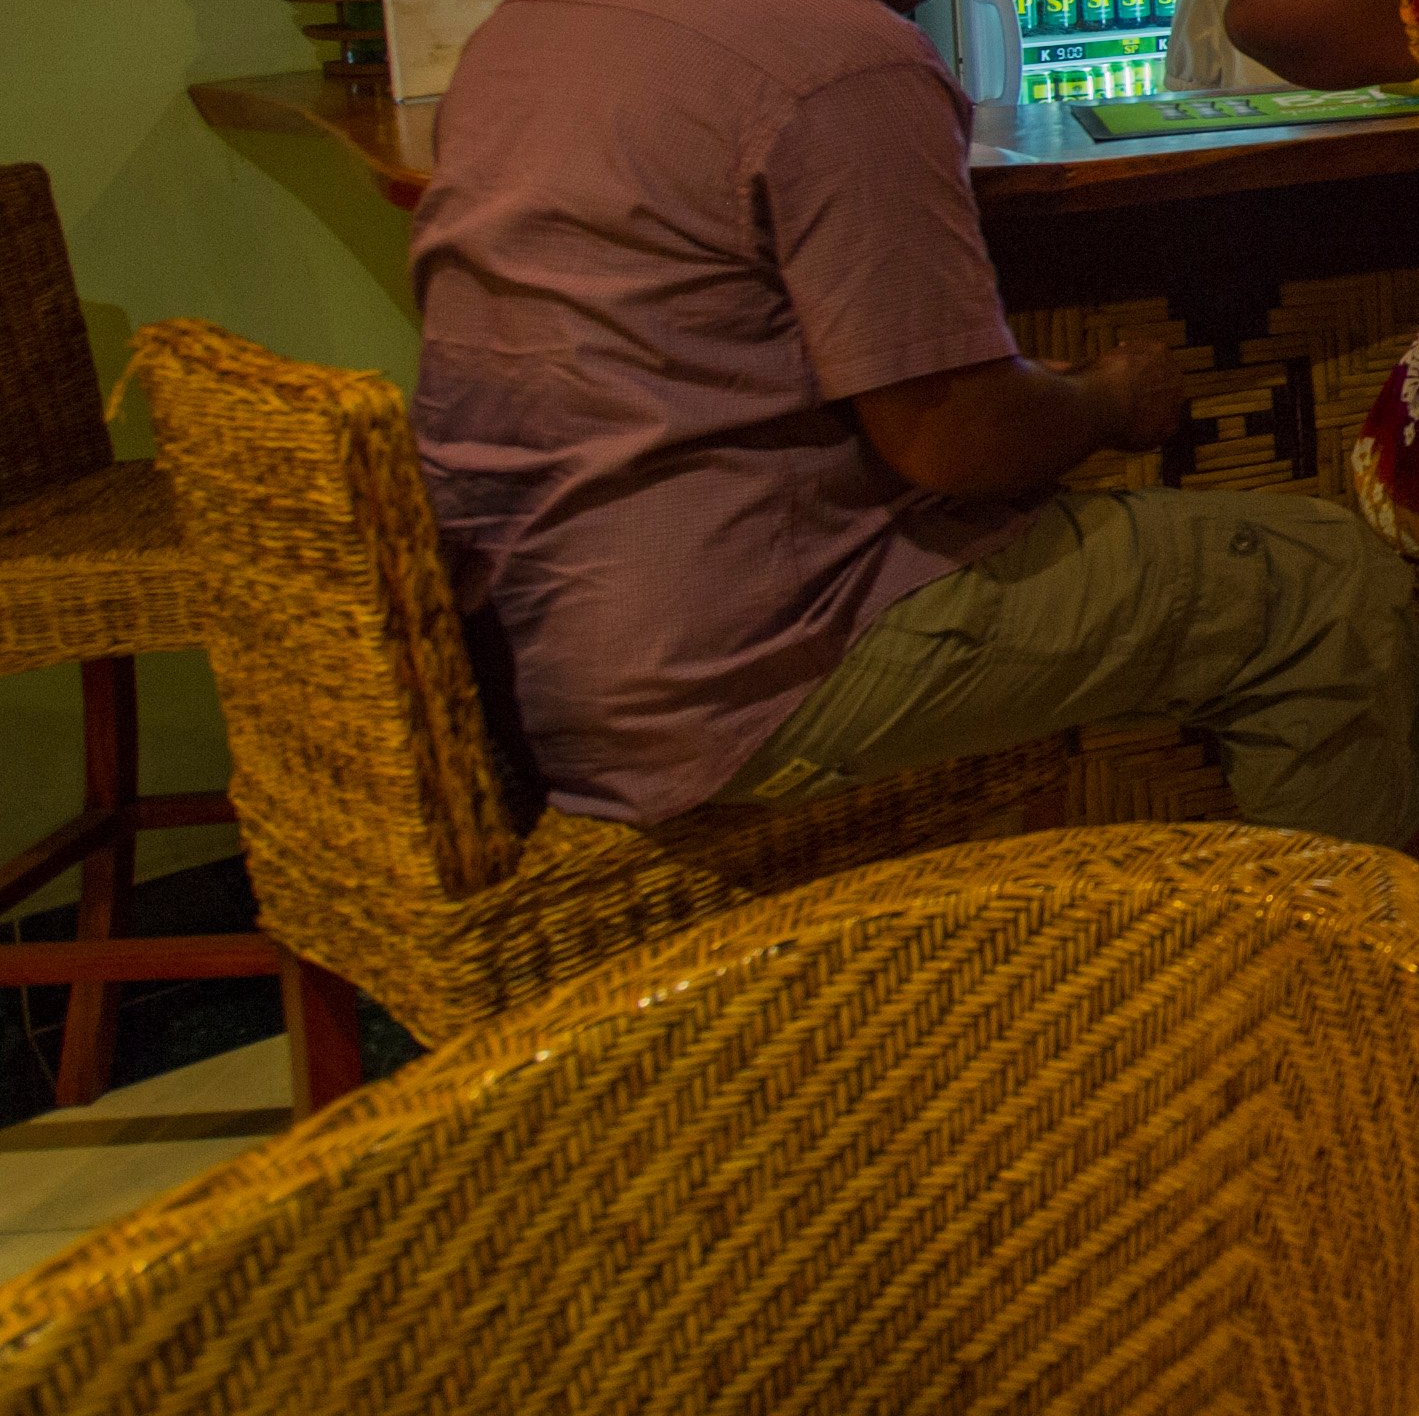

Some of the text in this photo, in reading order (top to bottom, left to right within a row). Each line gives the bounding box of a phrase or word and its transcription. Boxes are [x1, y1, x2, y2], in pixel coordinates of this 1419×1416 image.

[1041, 47, 1083, 61] K 9.00
[1123, 44, 1139, 54] SP
